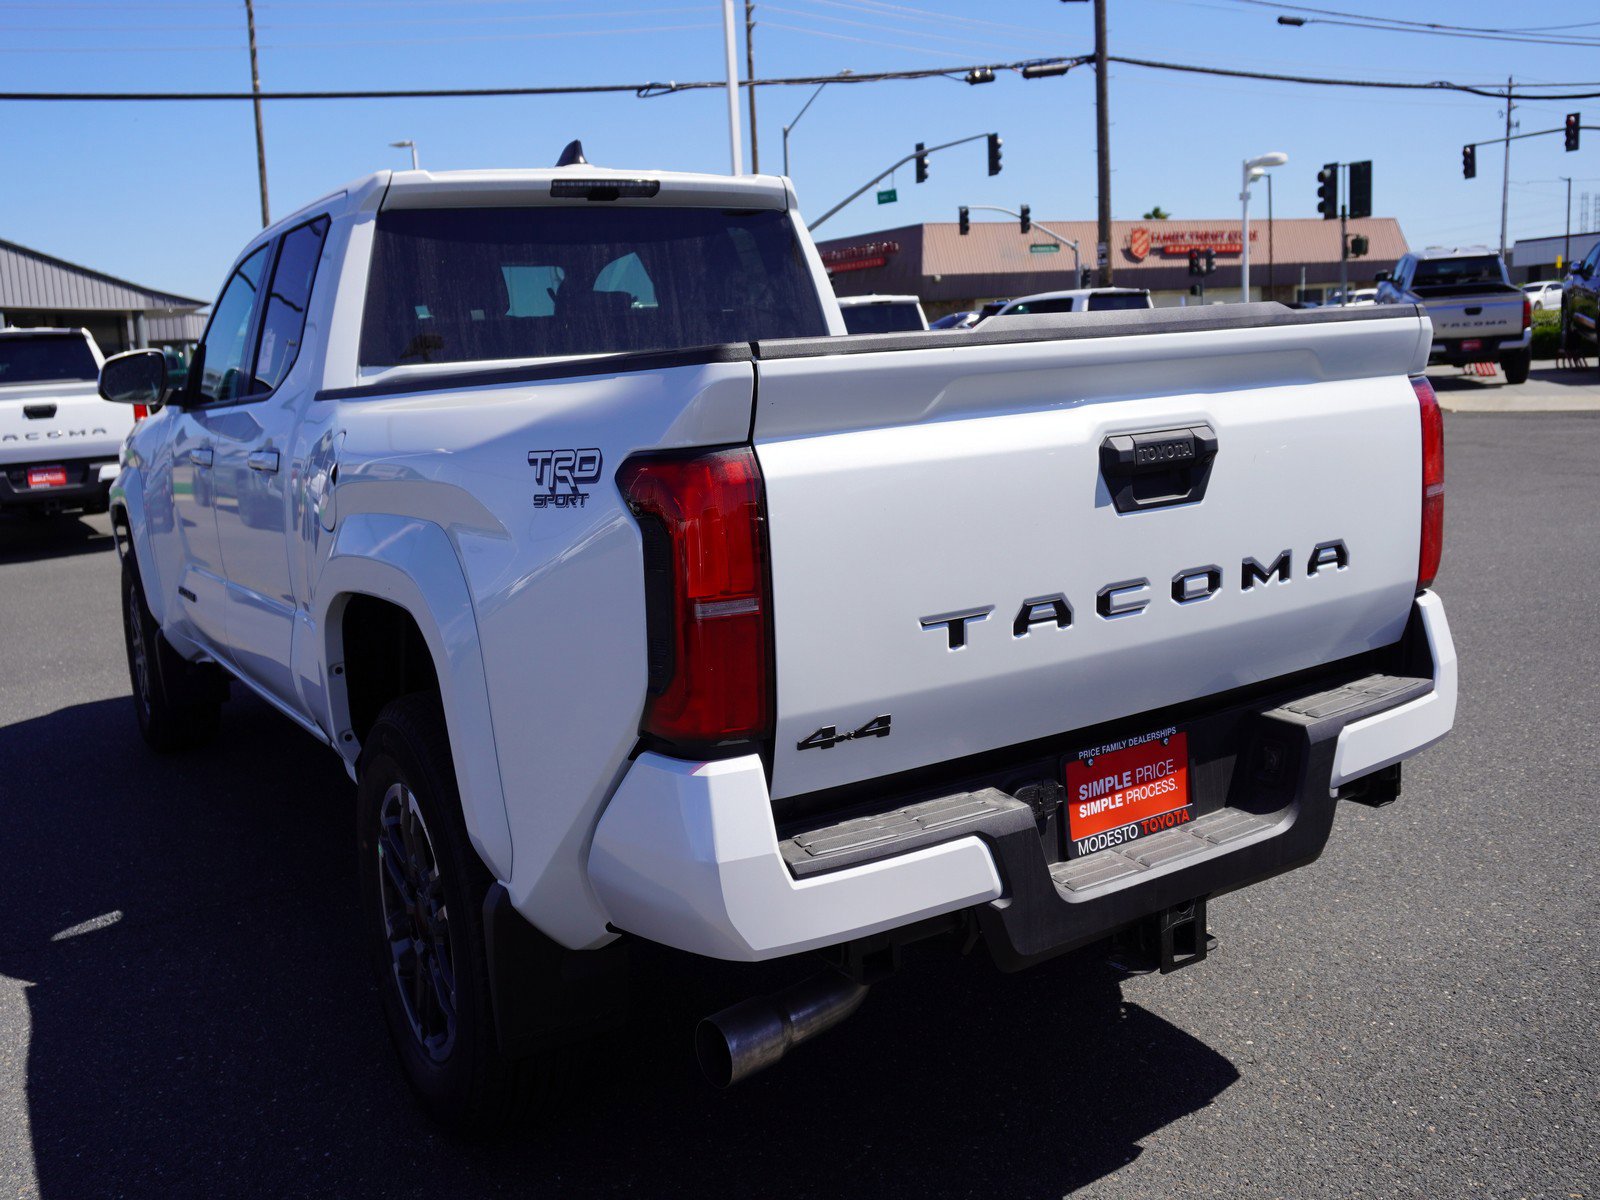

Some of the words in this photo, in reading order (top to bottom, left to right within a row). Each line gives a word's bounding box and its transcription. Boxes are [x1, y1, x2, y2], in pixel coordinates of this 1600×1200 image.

[527, 447, 604, 496] TRD
[1138, 441, 1193, 462] TOYOTA
[533, 492, 591, 508] SPORT
[918, 538, 1351, 651] TACOMA
[1078, 747, 1104, 760] PRICE
[1102, 740, 1127, 754] FAMILY
[1128, 726, 1177, 747] DEALERSHIPS
[1079, 770, 1133, 801] SIMPLE
[1135, 758, 1178, 784] PRICE.
[1079, 793, 1124, 819] SIMPLE
[1126, 778, 1179, 804] PROCESS.
[1078, 824, 1139, 856] MODESTO
[1141, 808, 1191, 835] TOYOTA
